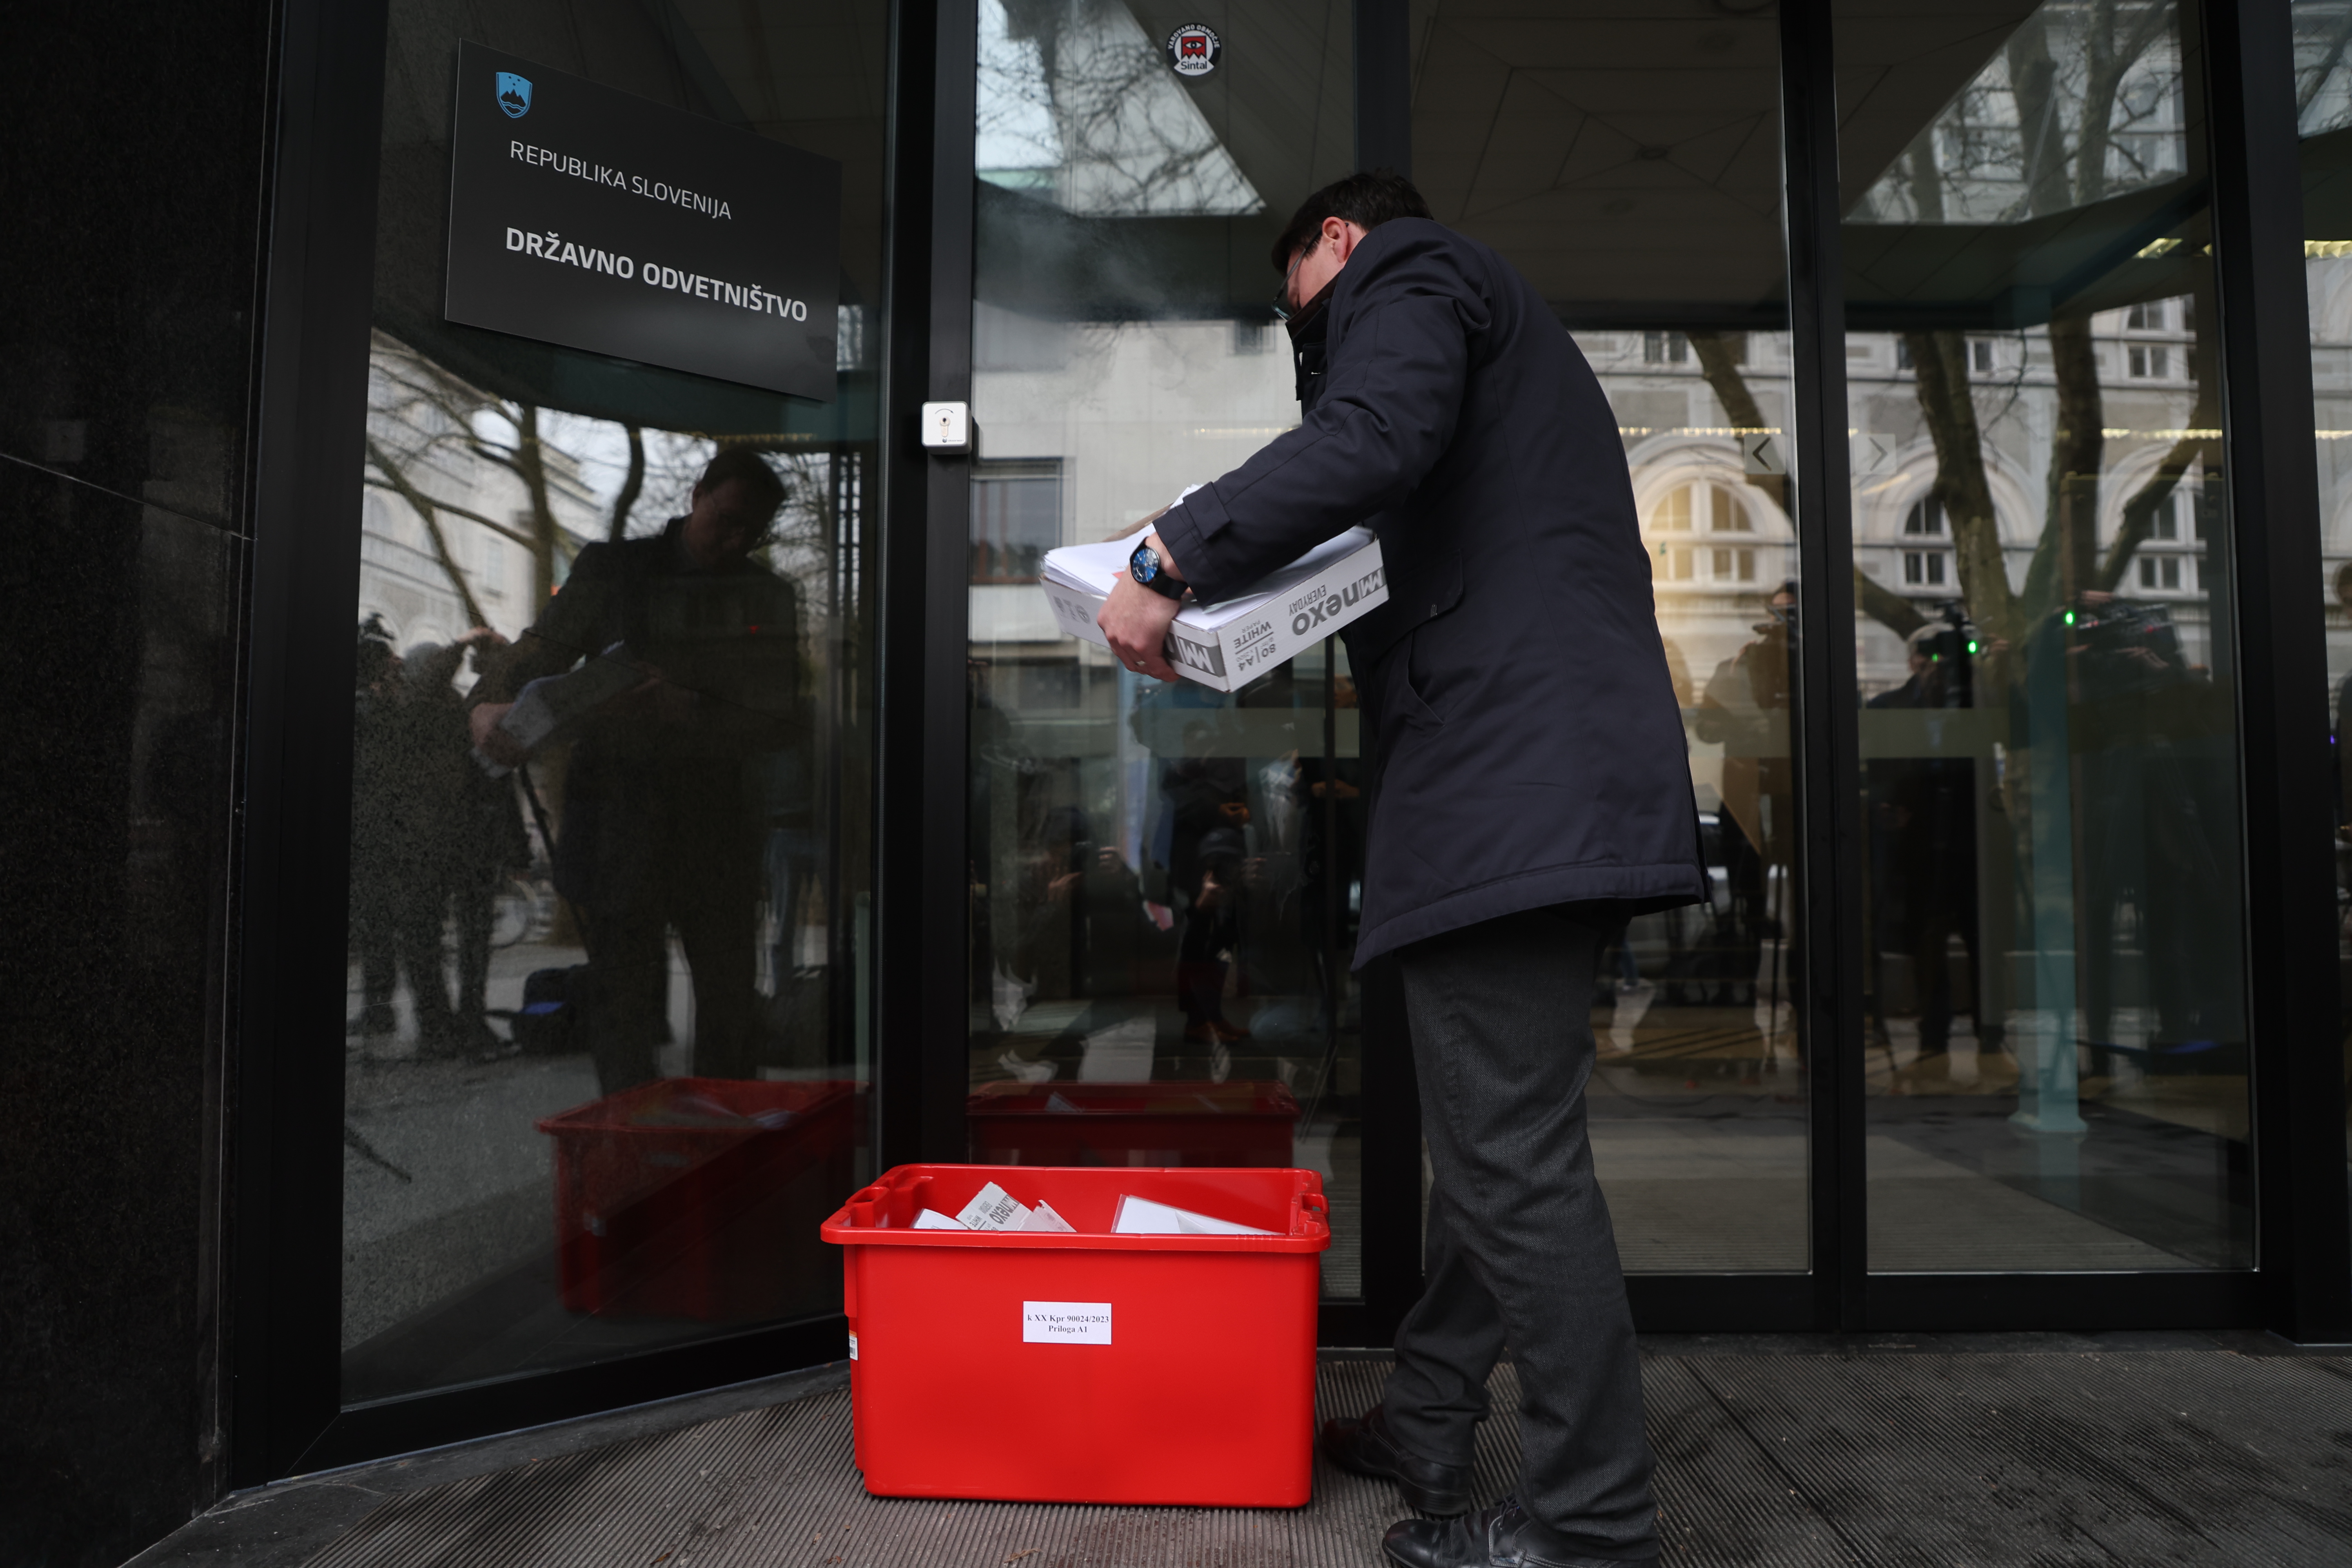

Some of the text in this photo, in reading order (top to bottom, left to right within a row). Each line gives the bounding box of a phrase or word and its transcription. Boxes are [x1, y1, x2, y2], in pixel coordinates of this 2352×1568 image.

[1167, 24, 1220, 49] VAROVANO OBMOČJE
[1181, 61, 1207, 69] Sintal
[510, 140, 731, 220] REPUBLIKA SLOVENIJA
[506, 226, 807, 321] DRŽAVNO ODVETNIŠTVO
[1289, 584, 1327, 616] EVERYDAY
[1233, 621, 1272, 648] WHITE
[1241, 619, 1260, 633] PAPER
[1238, 644, 1276, 671] 80 A4
[969, 1215, 983, 1227] WHITE
[1048, 1325, 1075, 1334] Priloga
[1050, 1315, 1065, 1323] Kpr
